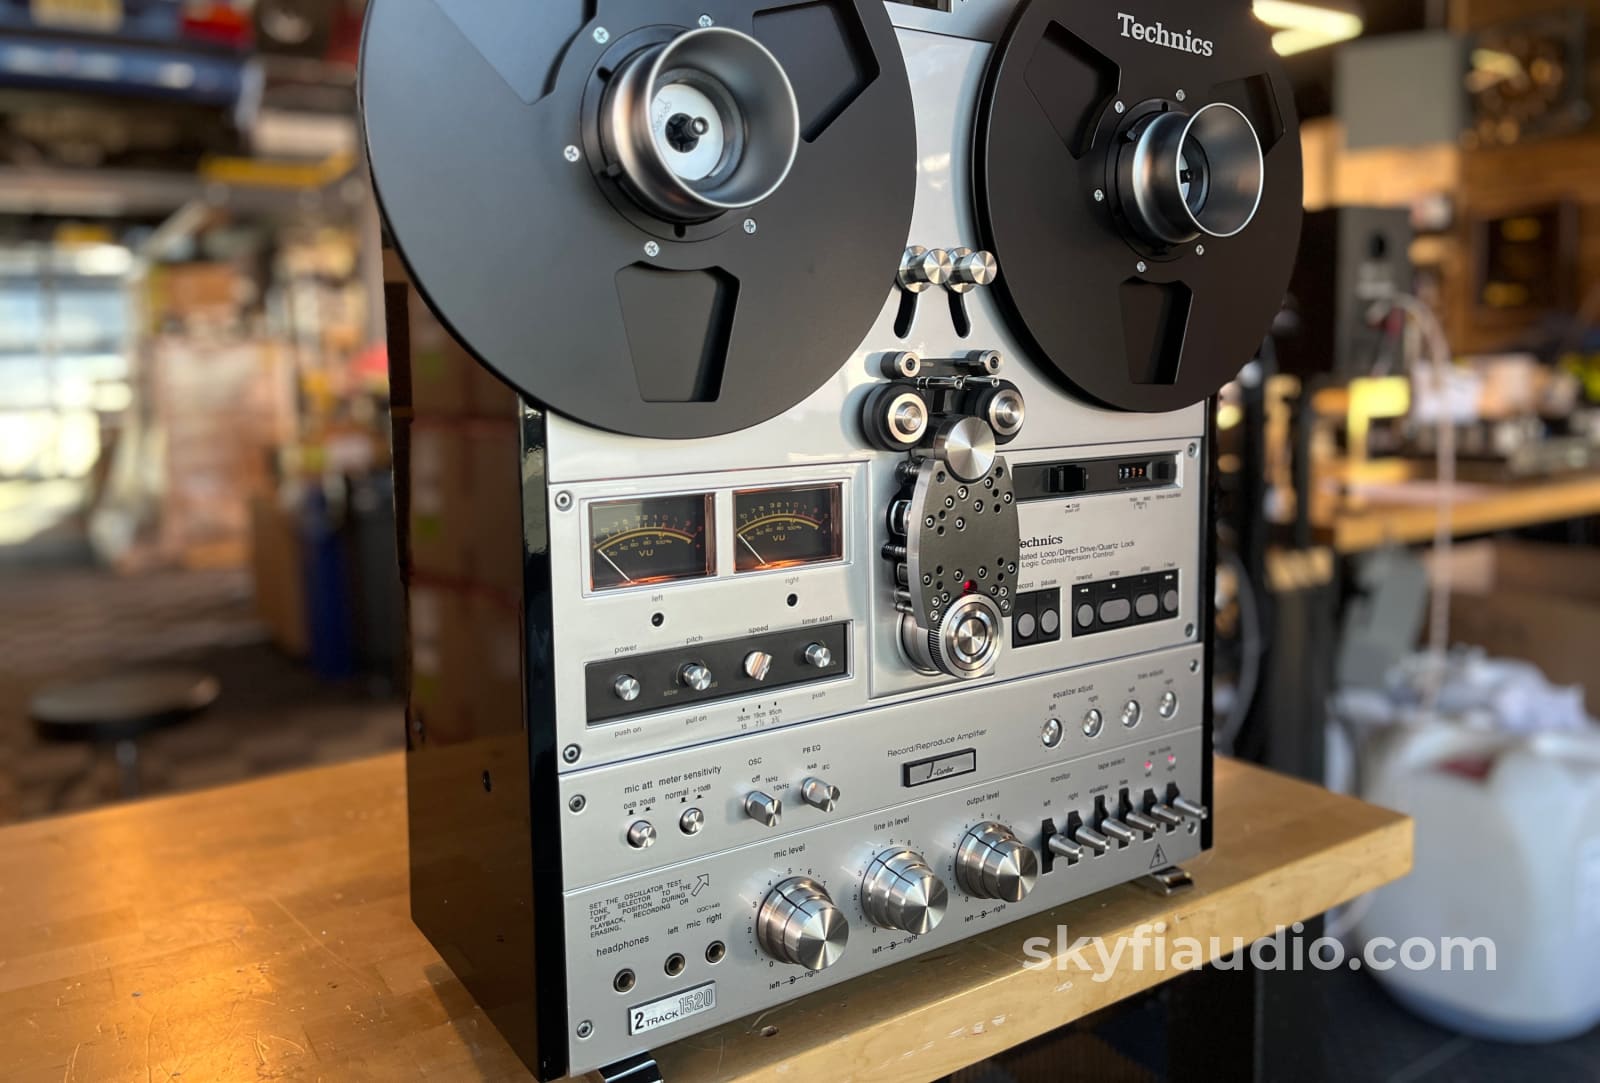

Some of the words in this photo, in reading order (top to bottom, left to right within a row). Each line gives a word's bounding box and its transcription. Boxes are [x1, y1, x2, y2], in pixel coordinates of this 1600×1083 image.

[1118, 12, 1214, 57] Technics
[1019, 535, 1063, 548] echnics
[638, 549, 654, 557] VU
[1019, 552, 1038, 560] lated
[1040, 548, 1078, 558] Loop/Direct
[1080, 542, 1118, 553] Drive/Quartz
[1021, 560, 1039, 568] Logic
[1041, 552, 1091, 564] Control/Tension
[1092, 550, 1114, 558] Control
[785, 576, 800, 585] right
[819, 614, 833, 623] start
[748, 624, 769, 634] speed
[686, 634, 703, 644] pitch
[614, 644, 637, 655] power
[1053, 688, 1076, 699] equalizer
[1077, 684, 1094, 694] adjust
[686, 717, 698, 725] pull
[614, 728, 631, 738] push
[812, 744, 821, 752] EQ
[887, 736, 955, 757] Record/Reproduce
[956, 729, 987, 741] Amplifier
[748, 757, 762, 766] OSC
[658, 774, 682, 786] meter
[683, 766, 722, 782] sensitivity
[751, 775, 761, 784] off
[765, 776, 779, 784] 1kHz
[1050, 772, 1071, 783] monitor
[624, 784, 640, 794] mic
[642, 781, 653, 790] att
[773, 783, 790, 792] 10kHz
[664, 788, 689, 801] normal
[966, 797, 985, 806] output
[986, 791, 1000, 801] level
[623, 800, 637, 810] 0dB
[639, 796, 656, 806] 20dB
[873, 821, 886, 832] line
[887, 820, 894, 828] in
[894, 816, 910, 826] level
[773, 848, 787, 859] mic
[788, 843, 806, 855] level
[589, 901, 602, 910] SET
[606, 897, 619, 905] THE
[624, 885, 663, 900] OSCILLATOR
[666, 879, 682, 889] TEST
[590, 907, 608, 916] TONE
[617, 895, 651, 909] SELECTOR
[622, 902, 652, 915] POSITION
[661, 892, 686, 904] DURING
[993, 904, 1006, 914] right
[590, 917, 626, 931] PLAYBACK,
[633, 904, 671, 919] RECORDING
[964, 914, 974, 923] left
[667, 926, 679, 936] left
[686, 920, 701, 930] mic
[706, 913, 722, 924] right
[590, 925, 622, 938] ERASING.
[903, 933, 918, 944] right
[596, 935, 650, 957] headphones
[872, 945, 883, 954] left
[769, 980, 781, 990] left
[635, 1012, 644, 1030] 2
[646, 1009, 679, 1028] TRACK
[679, 988, 713, 1015] 1520
